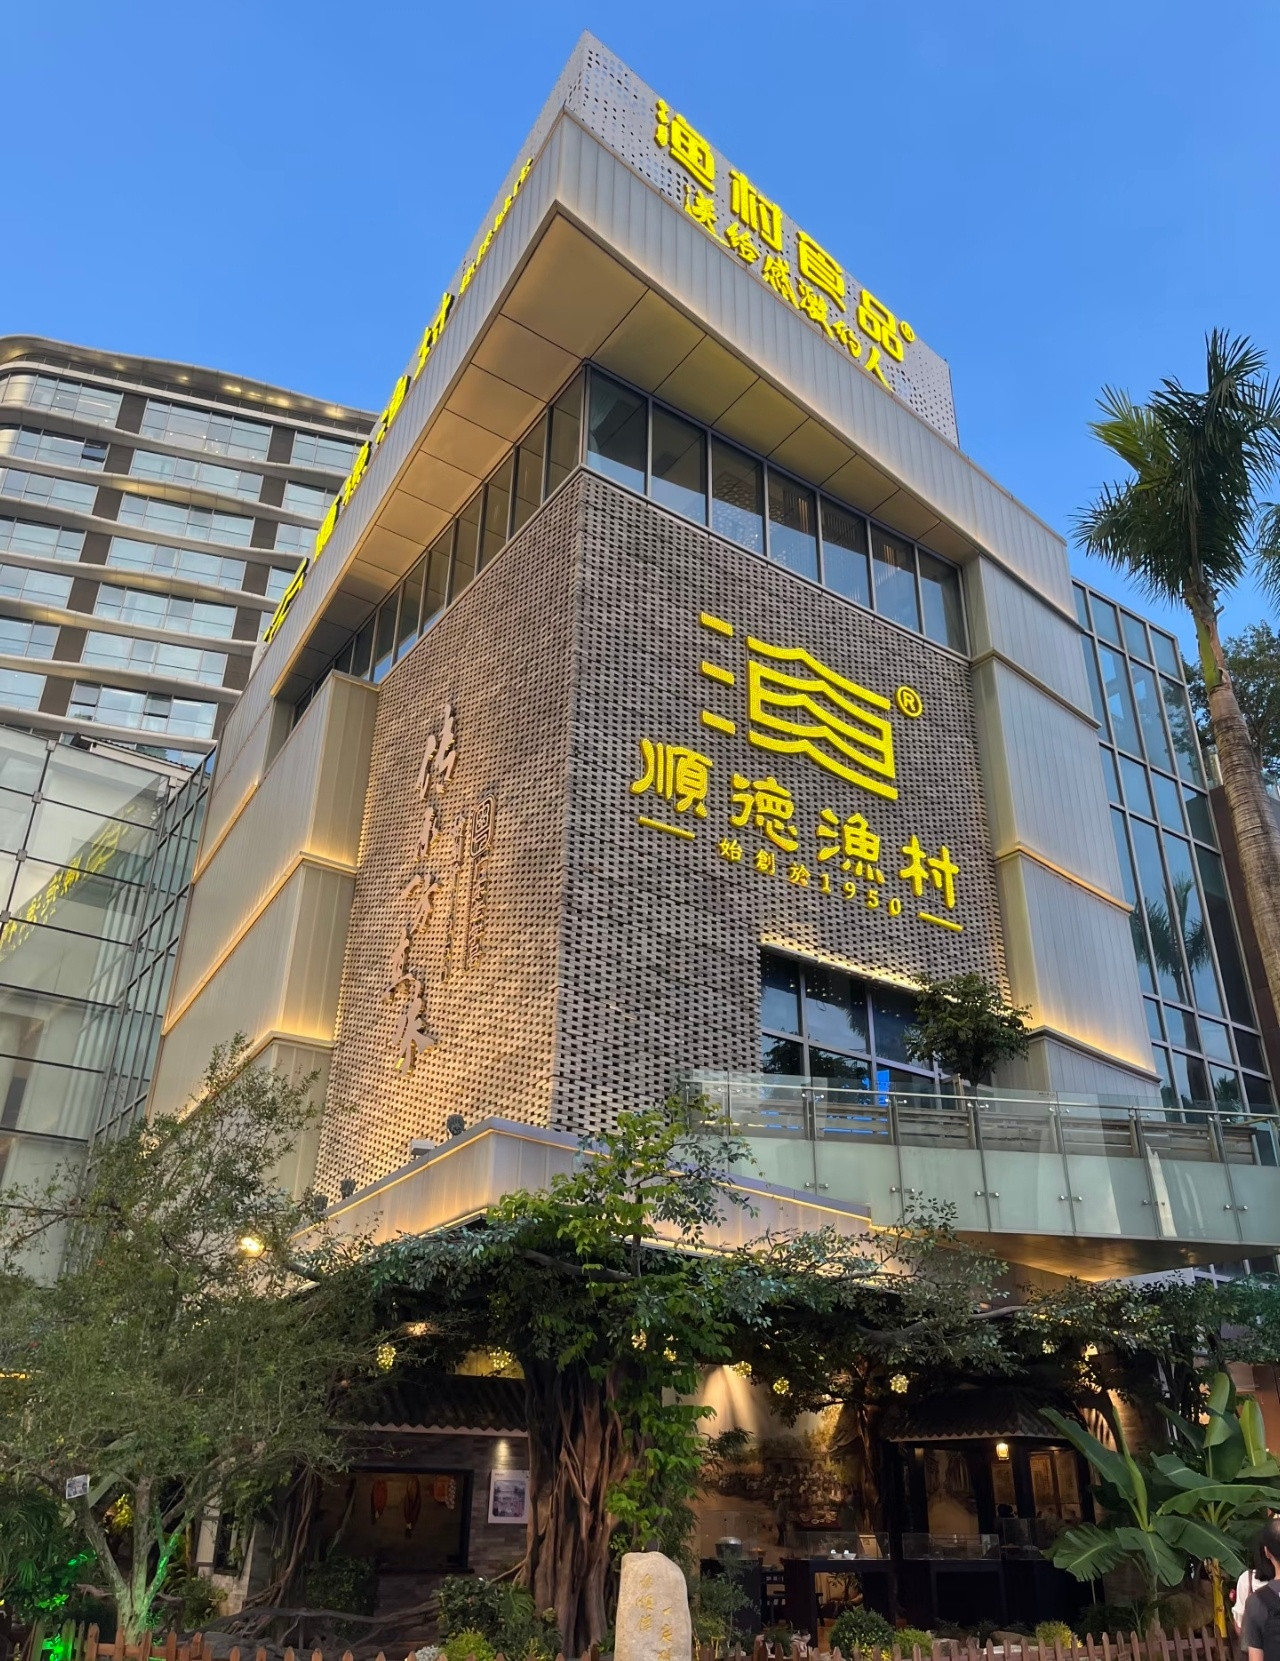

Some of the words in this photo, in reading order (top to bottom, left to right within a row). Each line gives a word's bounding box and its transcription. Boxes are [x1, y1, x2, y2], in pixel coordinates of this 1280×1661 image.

[629, 738, 960, 910] 順德漁村
[718, 838, 903, 917] 始創於1950
